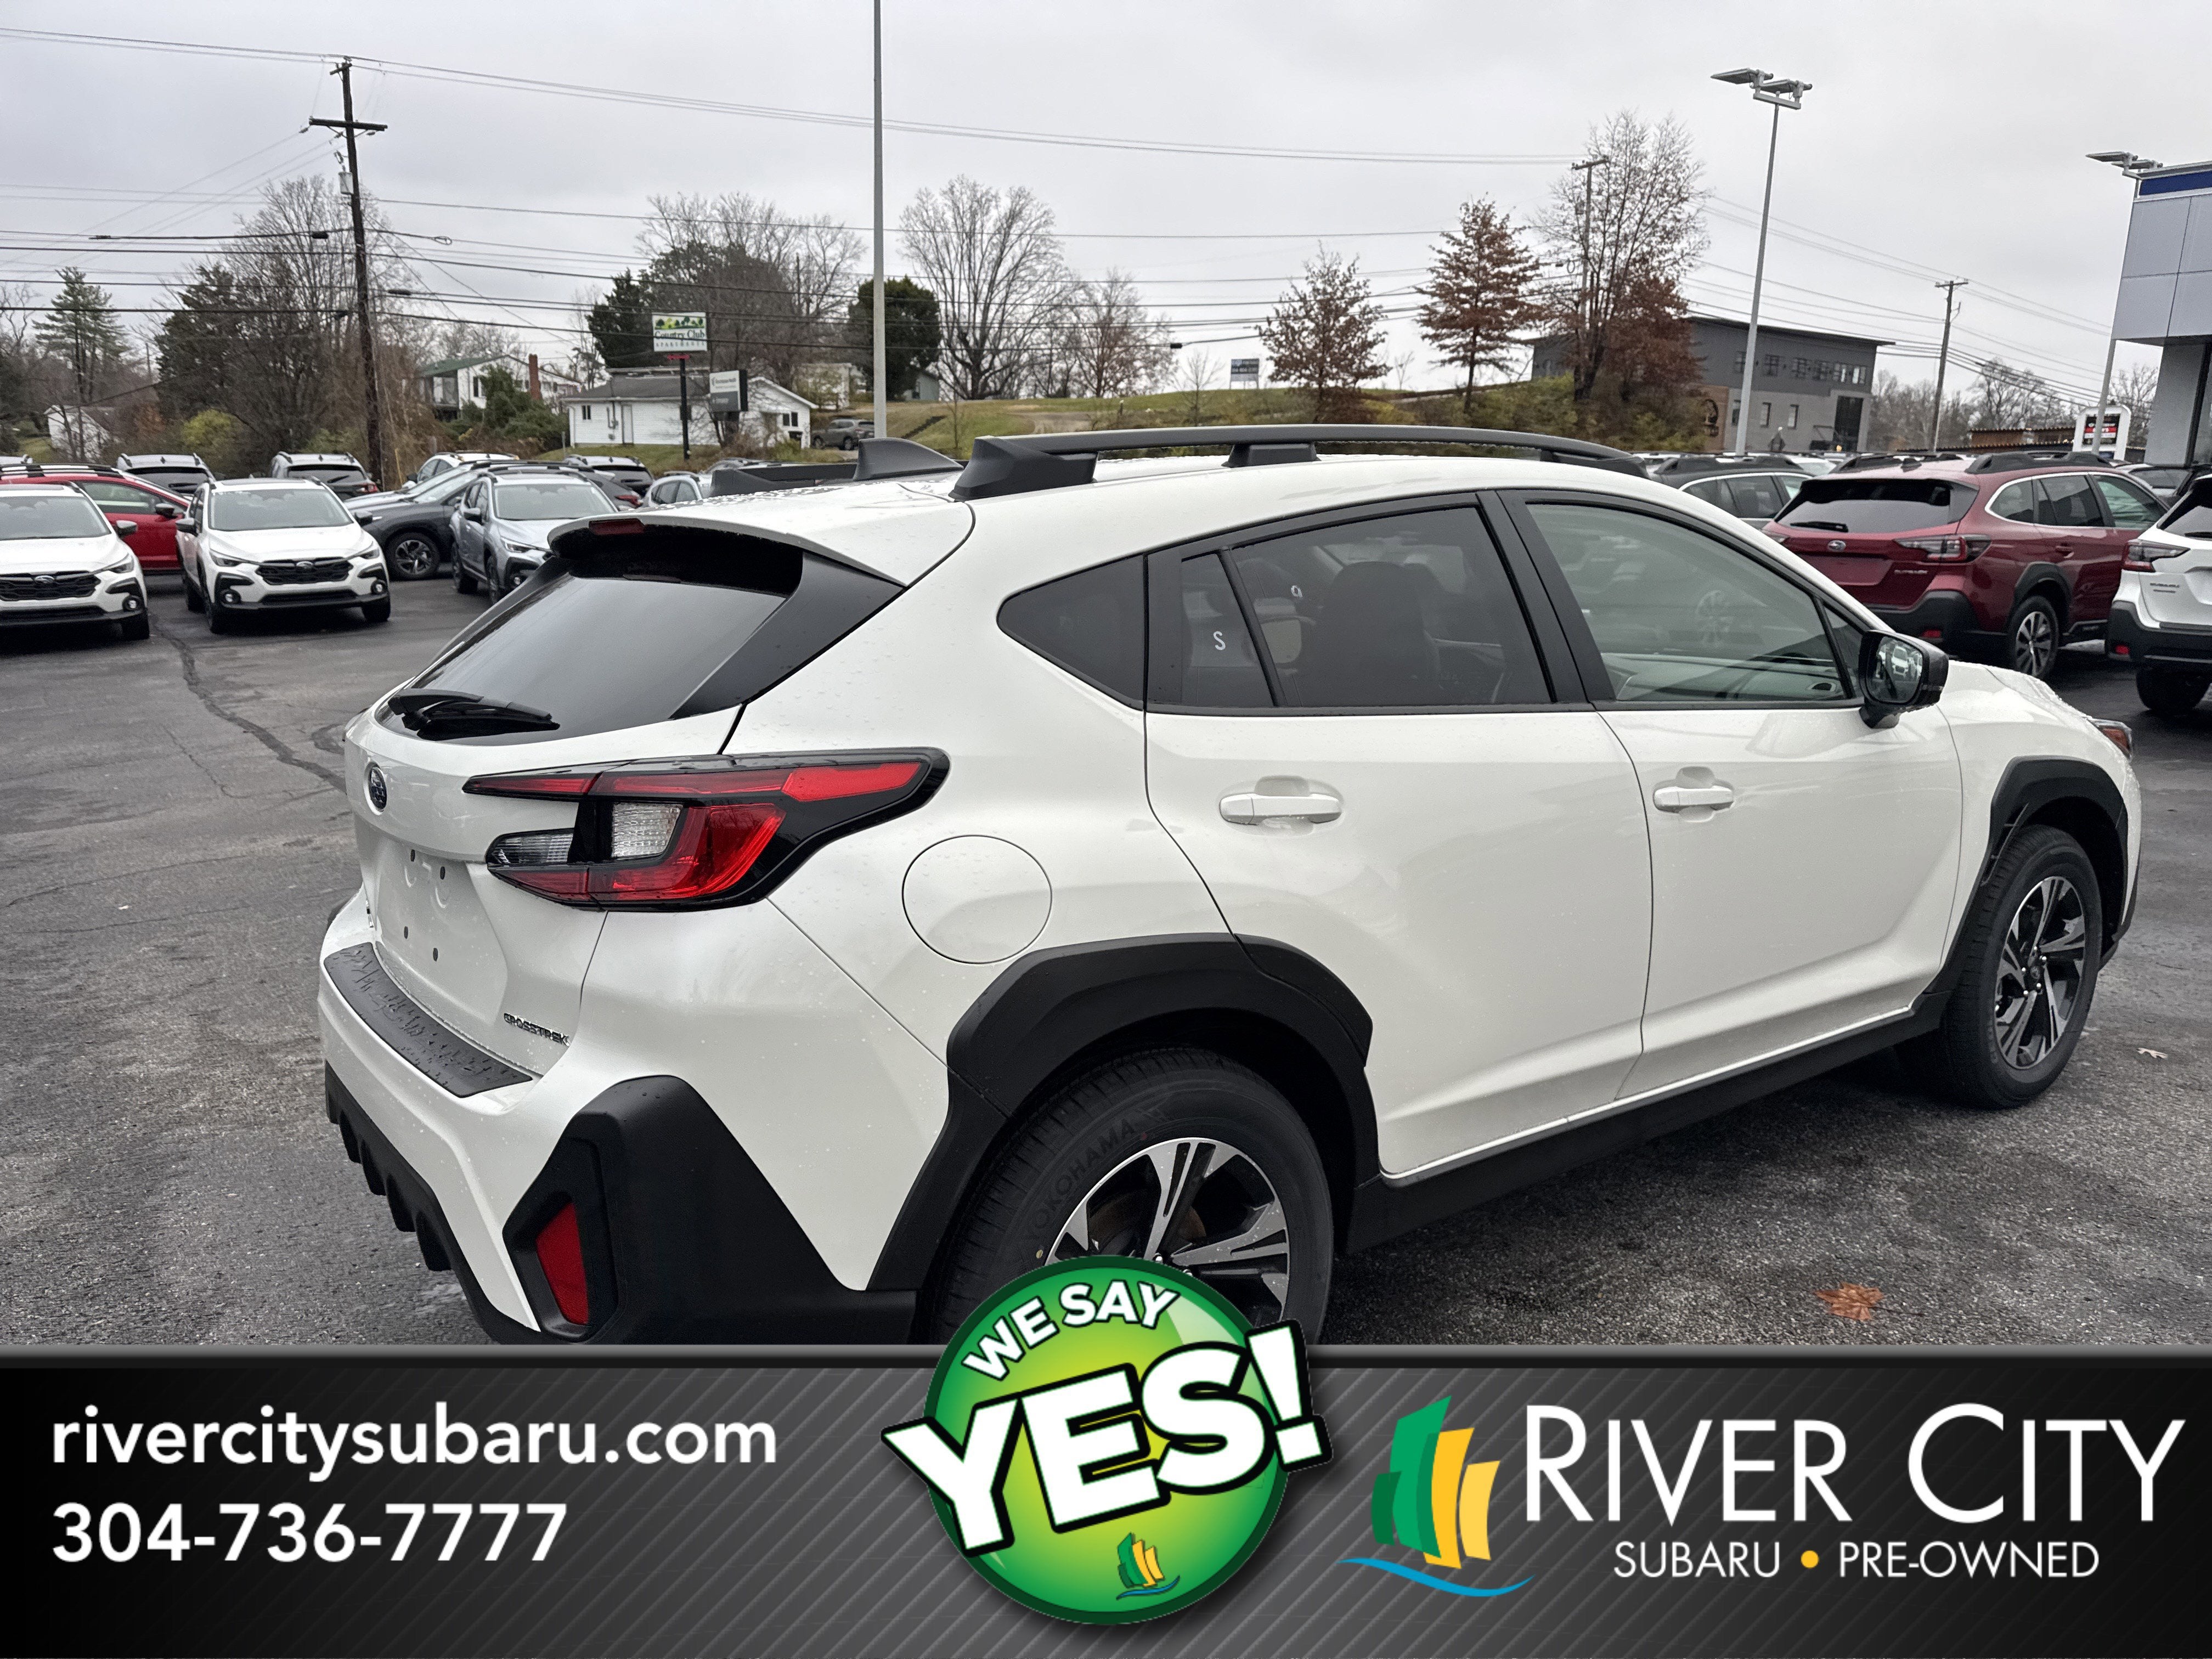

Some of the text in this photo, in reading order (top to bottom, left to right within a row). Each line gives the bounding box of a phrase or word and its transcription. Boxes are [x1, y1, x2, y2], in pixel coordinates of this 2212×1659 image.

[687, 329, 705, 338] Club
[1213, 631, 1226, 650] S
[504, 1013, 570, 1047] CROSSTREK
[1023, 1117, 1136, 1240] YOKOHAMA
